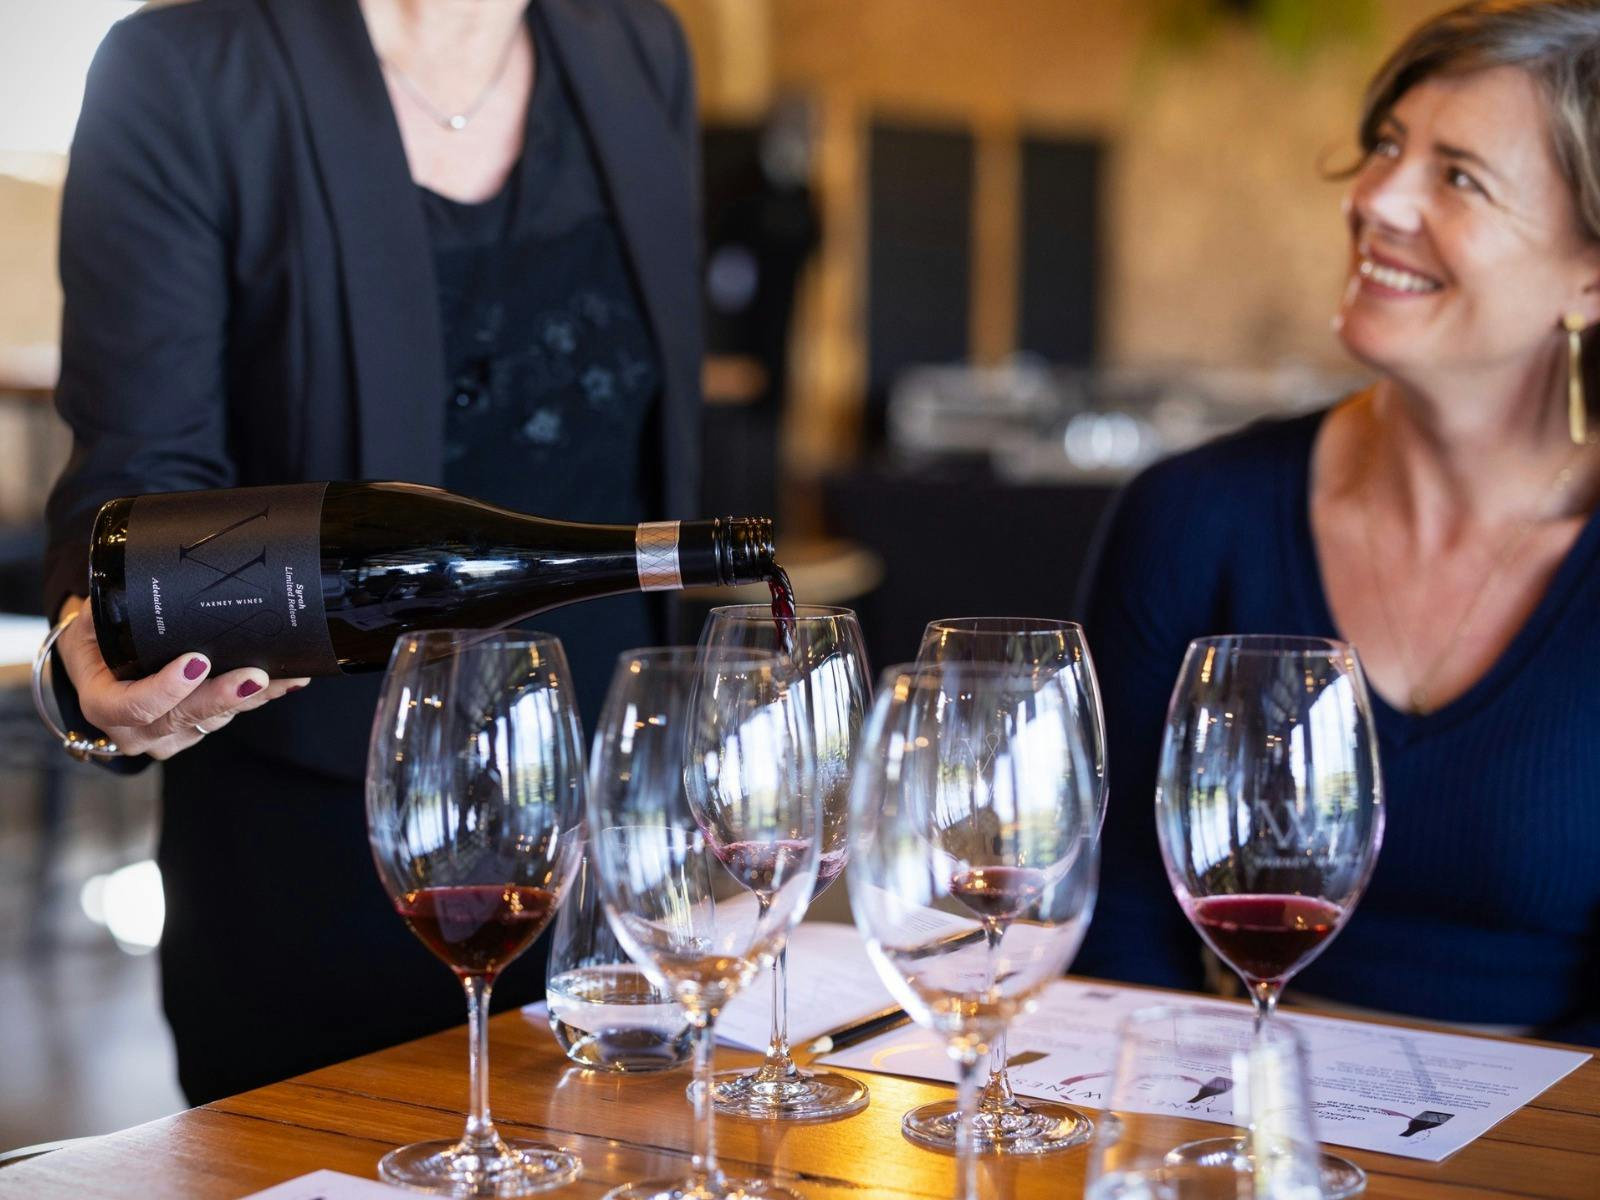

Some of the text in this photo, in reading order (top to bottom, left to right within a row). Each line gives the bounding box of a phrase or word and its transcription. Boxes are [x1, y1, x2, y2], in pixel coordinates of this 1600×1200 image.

[151, 577, 166, 635] Adelaide Hills
[200, 597, 263, 608] VARNEY WINES
[285, 566, 298, 628] Limited Release
[296, 583, 307, 610] Syrah
